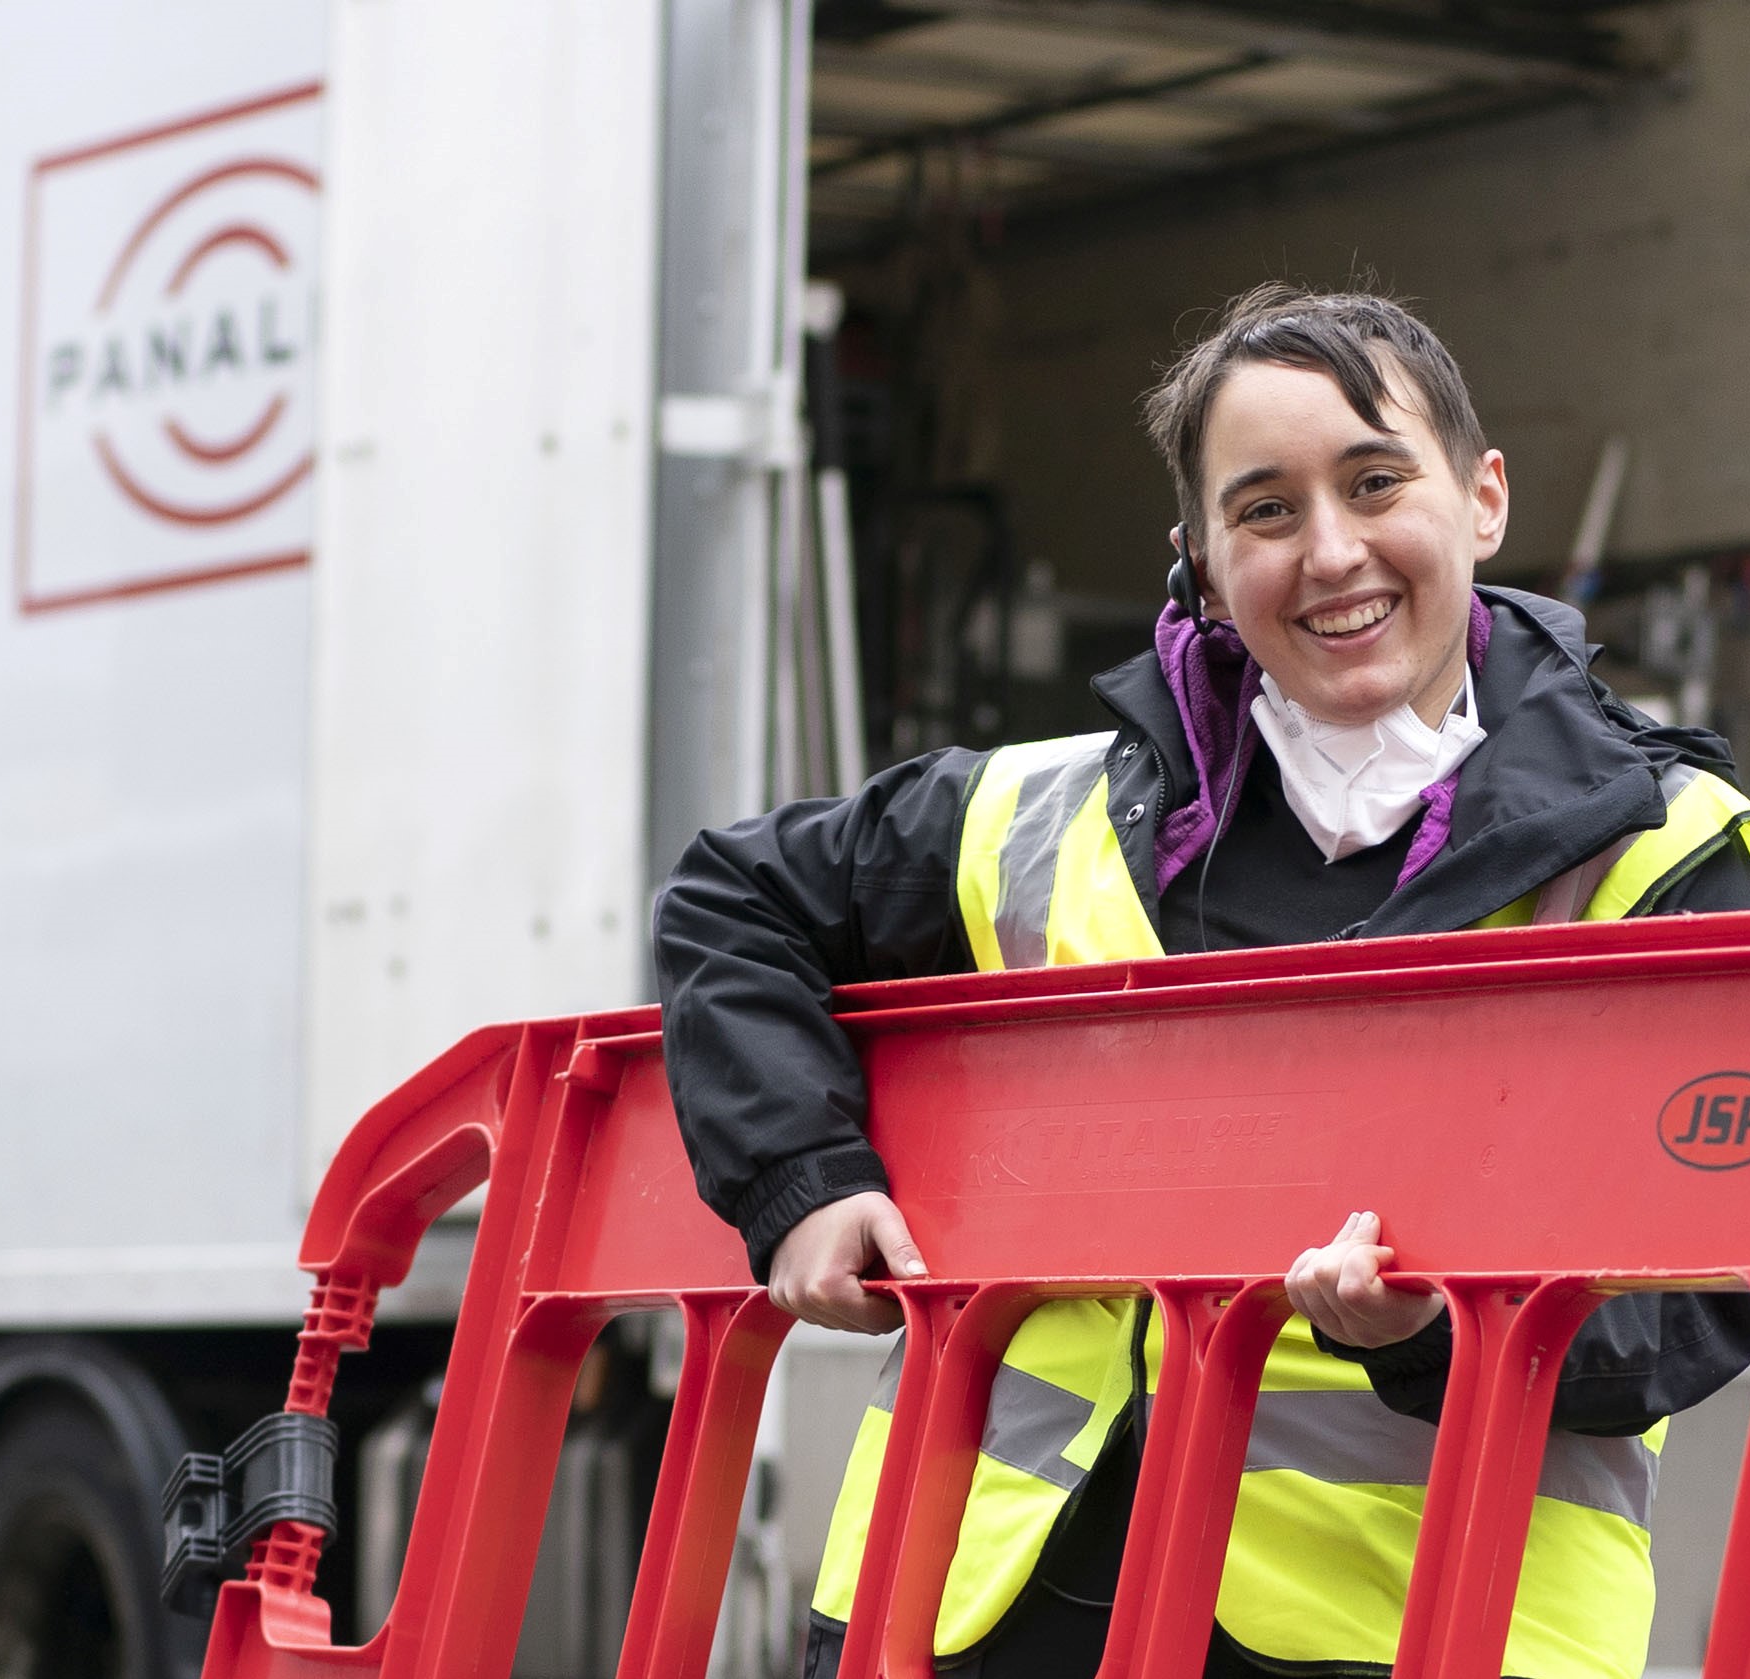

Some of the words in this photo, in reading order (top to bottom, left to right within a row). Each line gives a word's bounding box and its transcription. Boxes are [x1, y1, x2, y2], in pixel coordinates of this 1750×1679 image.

[48, 288, 322, 411] PANAL
[1039, 1116, 1202, 1160] TITAN
[1210, 1112, 1284, 1138] ONE
